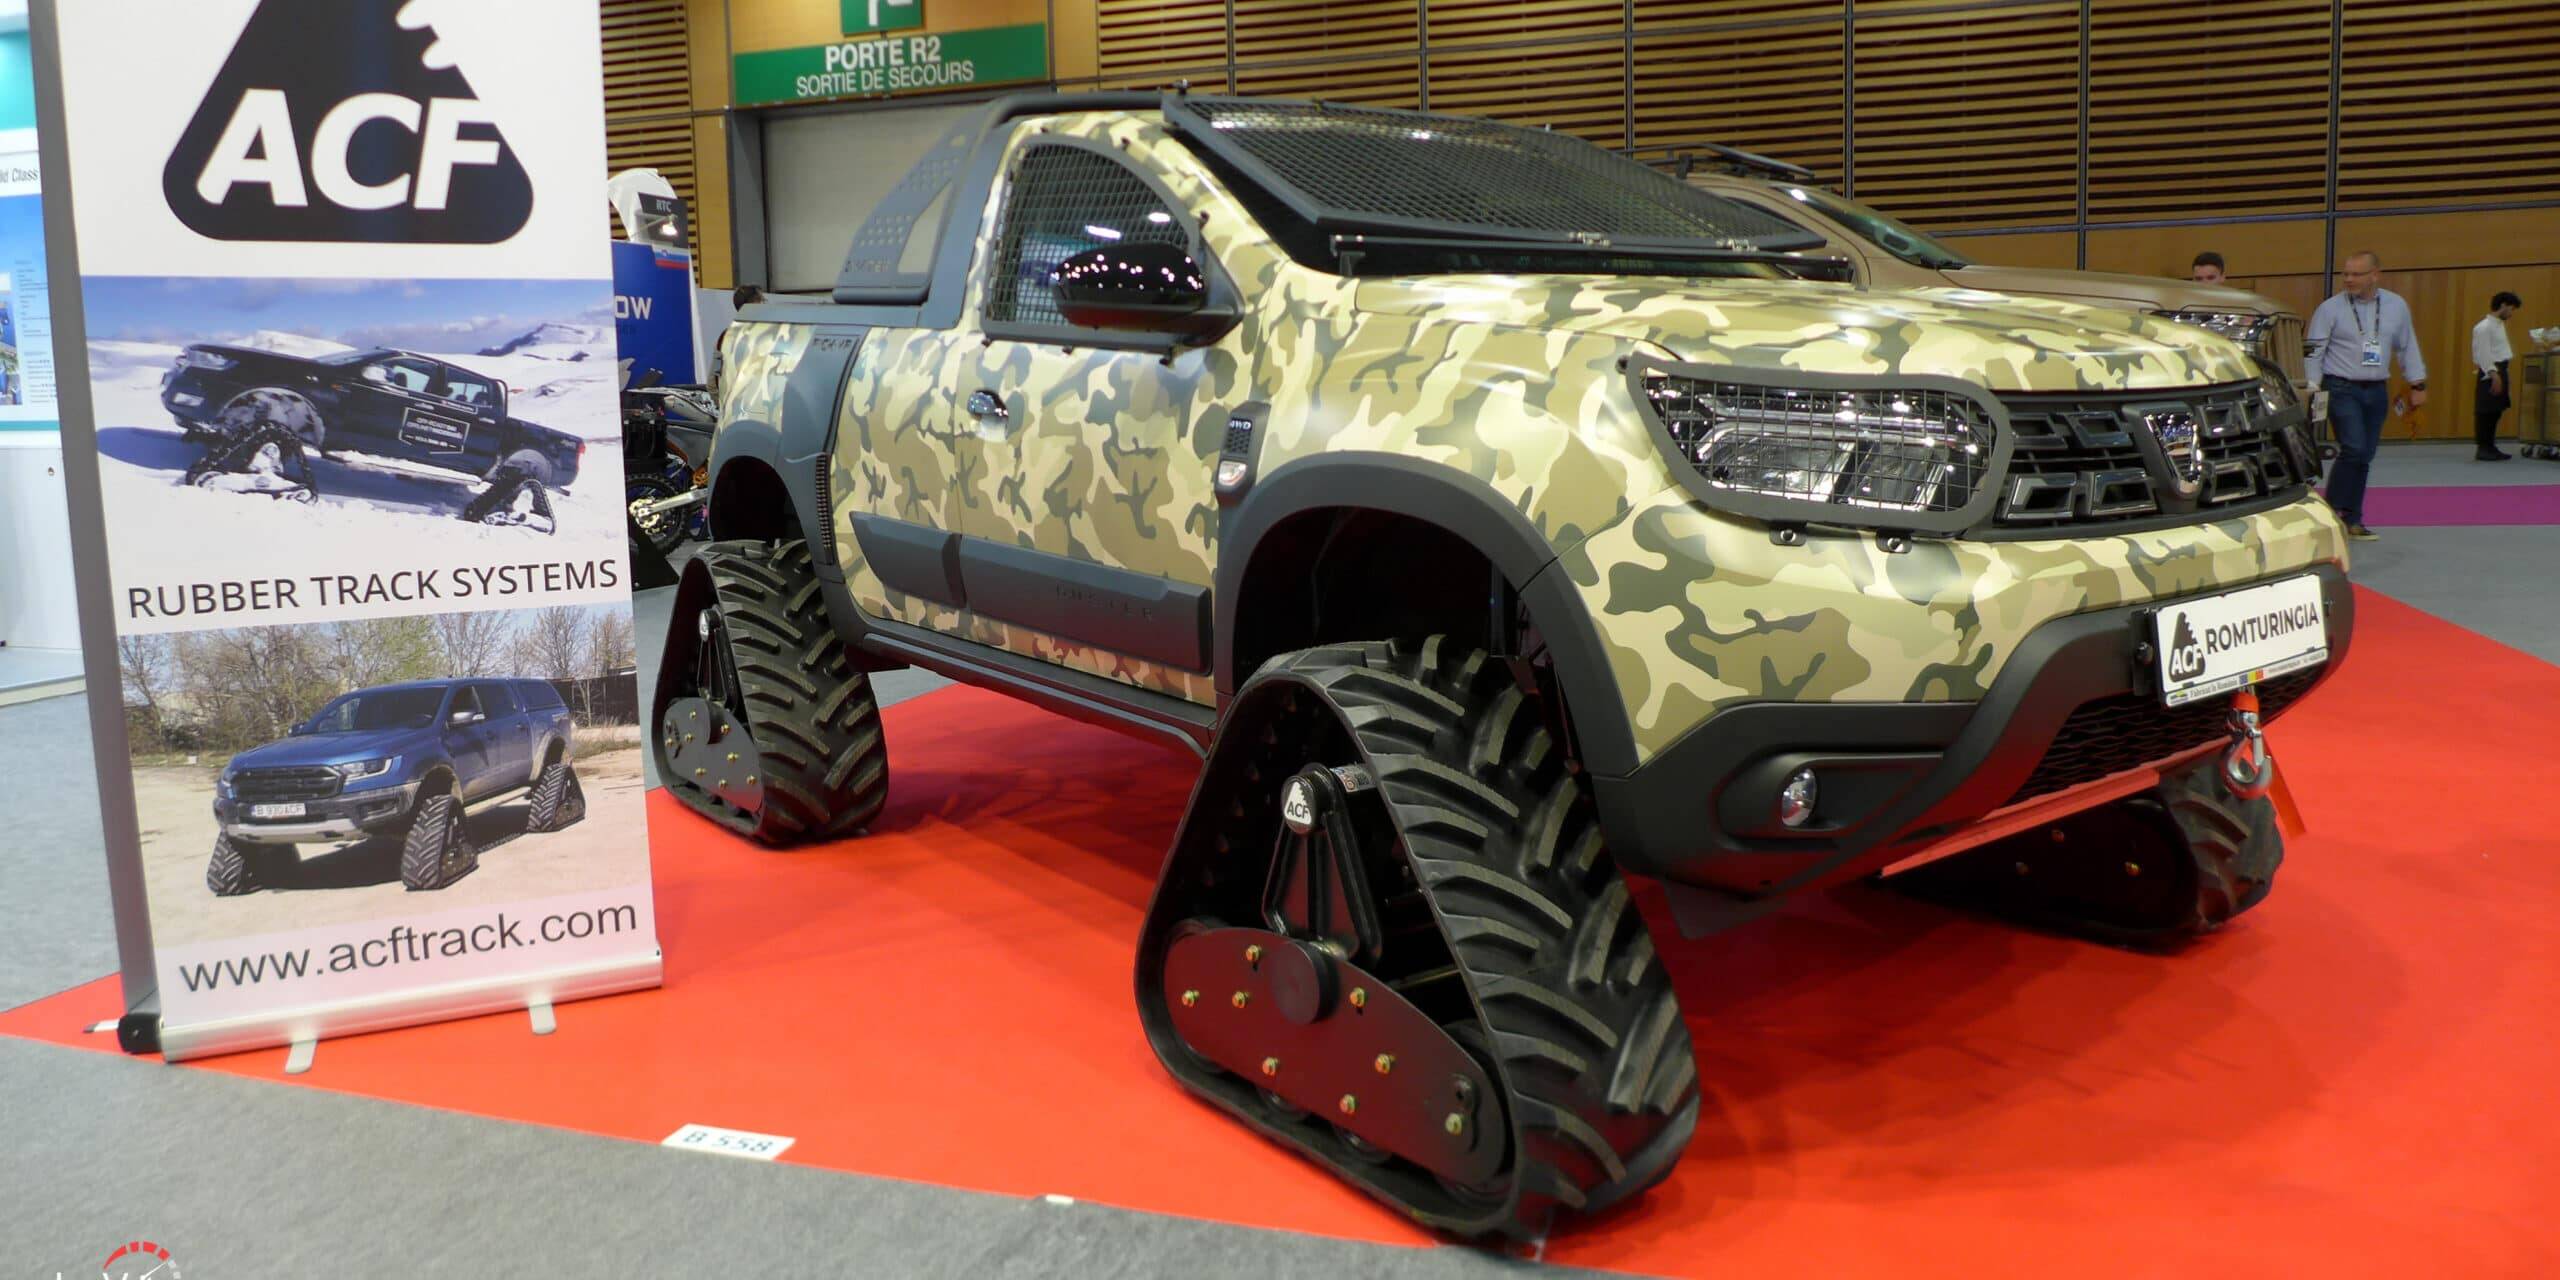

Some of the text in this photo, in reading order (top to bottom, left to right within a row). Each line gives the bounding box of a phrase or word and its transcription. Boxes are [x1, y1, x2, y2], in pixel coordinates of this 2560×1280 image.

[825, 35, 942, 72] PORTE R2
[796, 60, 975, 97] SORTIE DE SECOURS
[196, 88, 501, 211] ACF
[655, 199, 673, 213] RTC
[128, 558, 619, 619] RUBBER TRACK SYSTEMS
[2205, 602, 2319, 654] ROMTURINGIA
[2171, 645, 2204, 677] ACF
[1286, 801, 1309, 819] ACF
[179, 903, 637, 993] www.acftrack.com
[712, 1135, 775, 1153] 558
